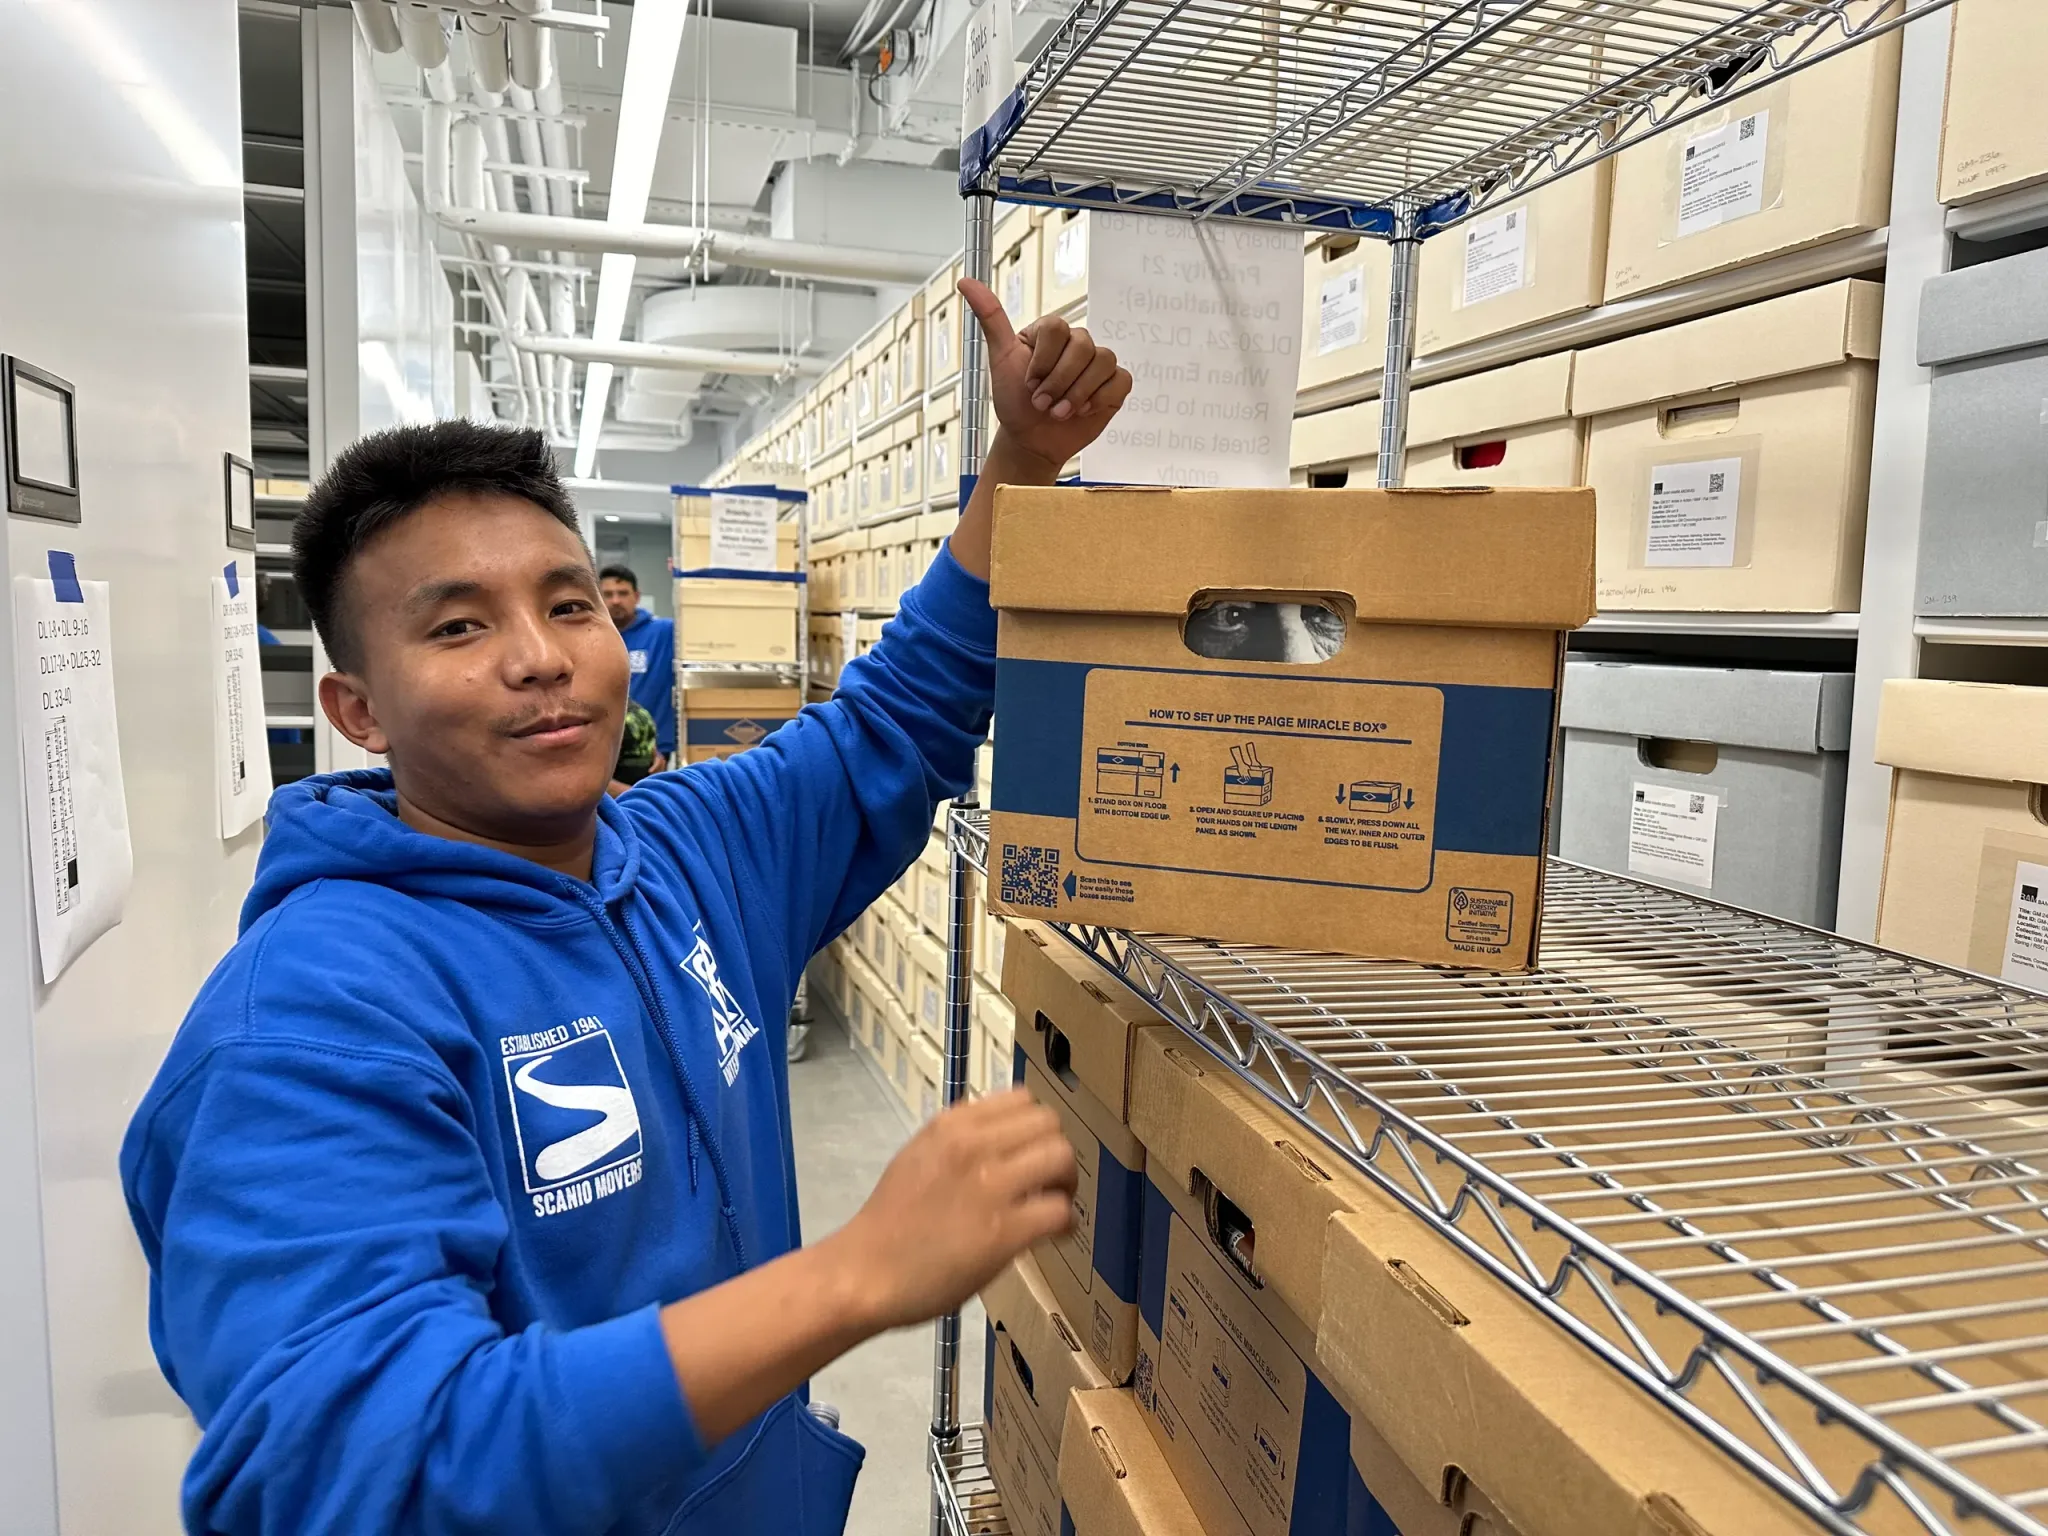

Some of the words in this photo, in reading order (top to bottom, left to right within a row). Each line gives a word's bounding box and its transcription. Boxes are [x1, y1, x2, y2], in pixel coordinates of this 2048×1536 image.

[38, 621, 48, 639] DL
[61, 619, 71, 637] DL
[72, 618, 89, 636] 9-16
[70, 649, 102, 669] DL25-32
[42, 691, 54, 710] DL
[54, 686, 72, 708] 33-40
[1149, 709, 1174, 720] HOW
[1176, 711, 1191, 721] TO
[1193, 712, 1213, 723] SET
[1216, 714, 1231, 724] UP
[1234, 715, 1255, 725] THE
[1257, 716, 1294, 728] PAIGE
[1297, 718, 1350, 731] MIRACLE
[1094, 797, 1116, 805] STAND
[1133, 800, 1143, 808] ON
[1111, 809, 1139, 817] BOTTOM
[1196, 806, 1215, 814] OPEN
[1232, 809, 1262, 818] SQUARE
[1274, 812, 1304, 821] PLACING
[1196, 817, 1215, 825] YOUR
[1216, 818, 1241, 827] HANDS
[1254, 821, 1269, 829] THE
[1269, 822, 1298, 831] LENGTH
[1357, 819, 1381, 827] PRESS
[1382, 820, 1406, 829] DOWN
[1195, 827, 1217, 835] PANEL
[1218, 828, 1228, 836] AS
[1359, 829, 1381, 837] INNER
[1382, 831, 1399, 839] AND
[1400, 833, 1426, 841] OUTER
[1324, 837, 1349, 846] EDGES
[1361, 840, 1372, 848] BE
[1080, 876, 1097, 884] Scan
[1097, 877, 1110, 885] this
[1095, 885, 1114, 894] easily
[1115, 887, 1134, 895] these
[1079, 892, 1099, 900] boxes
[1469, 898, 1508, 907] SUSTAINABLE
[1469, 903, 1498, 911] FORESTRY
[1469, 909, 1497, 917] INITIATIVE
[2018, 913, 2028, 921] Box
[2017, 919, 2040, 930] Location:
[2015, 926, 2043, 938] Collection:
[2015, 932, 2032, 941] Series:
[1453, 943, 1476, 953] MADE
[500, 1024, 569, 1056] ESTABLISHED
[571, 1015, 604, 1036] 1941
[532, 1180, 593, 1218] SCANIO
[594, 1158, 643, 1200] MOVERS
[1227, 1318, 1244, 1343] PAIGE
